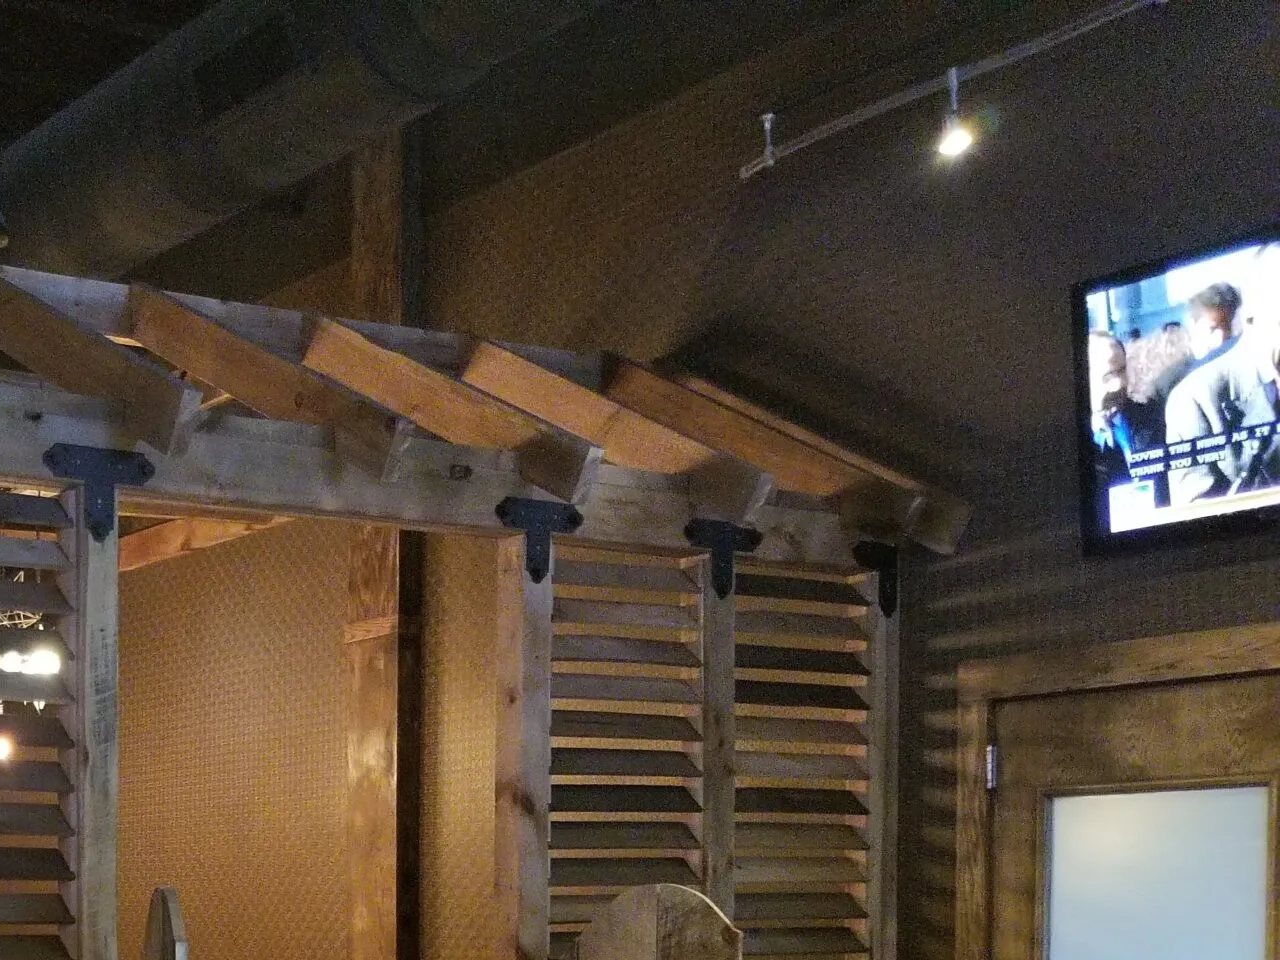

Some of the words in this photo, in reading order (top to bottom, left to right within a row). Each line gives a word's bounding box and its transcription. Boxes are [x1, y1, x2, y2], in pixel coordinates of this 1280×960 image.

[1130, 448, 1164, 464] COVER
[1169, 442, 1192, 455] THE
[1232, 430, 1248, 442] AS
[1255, 425, 1270, 437] IT
[1130, 463, 1164, 478] THANK
[1170, 457, 1192, 470] YOU
[1197, 450, 1226, 463] VERY
